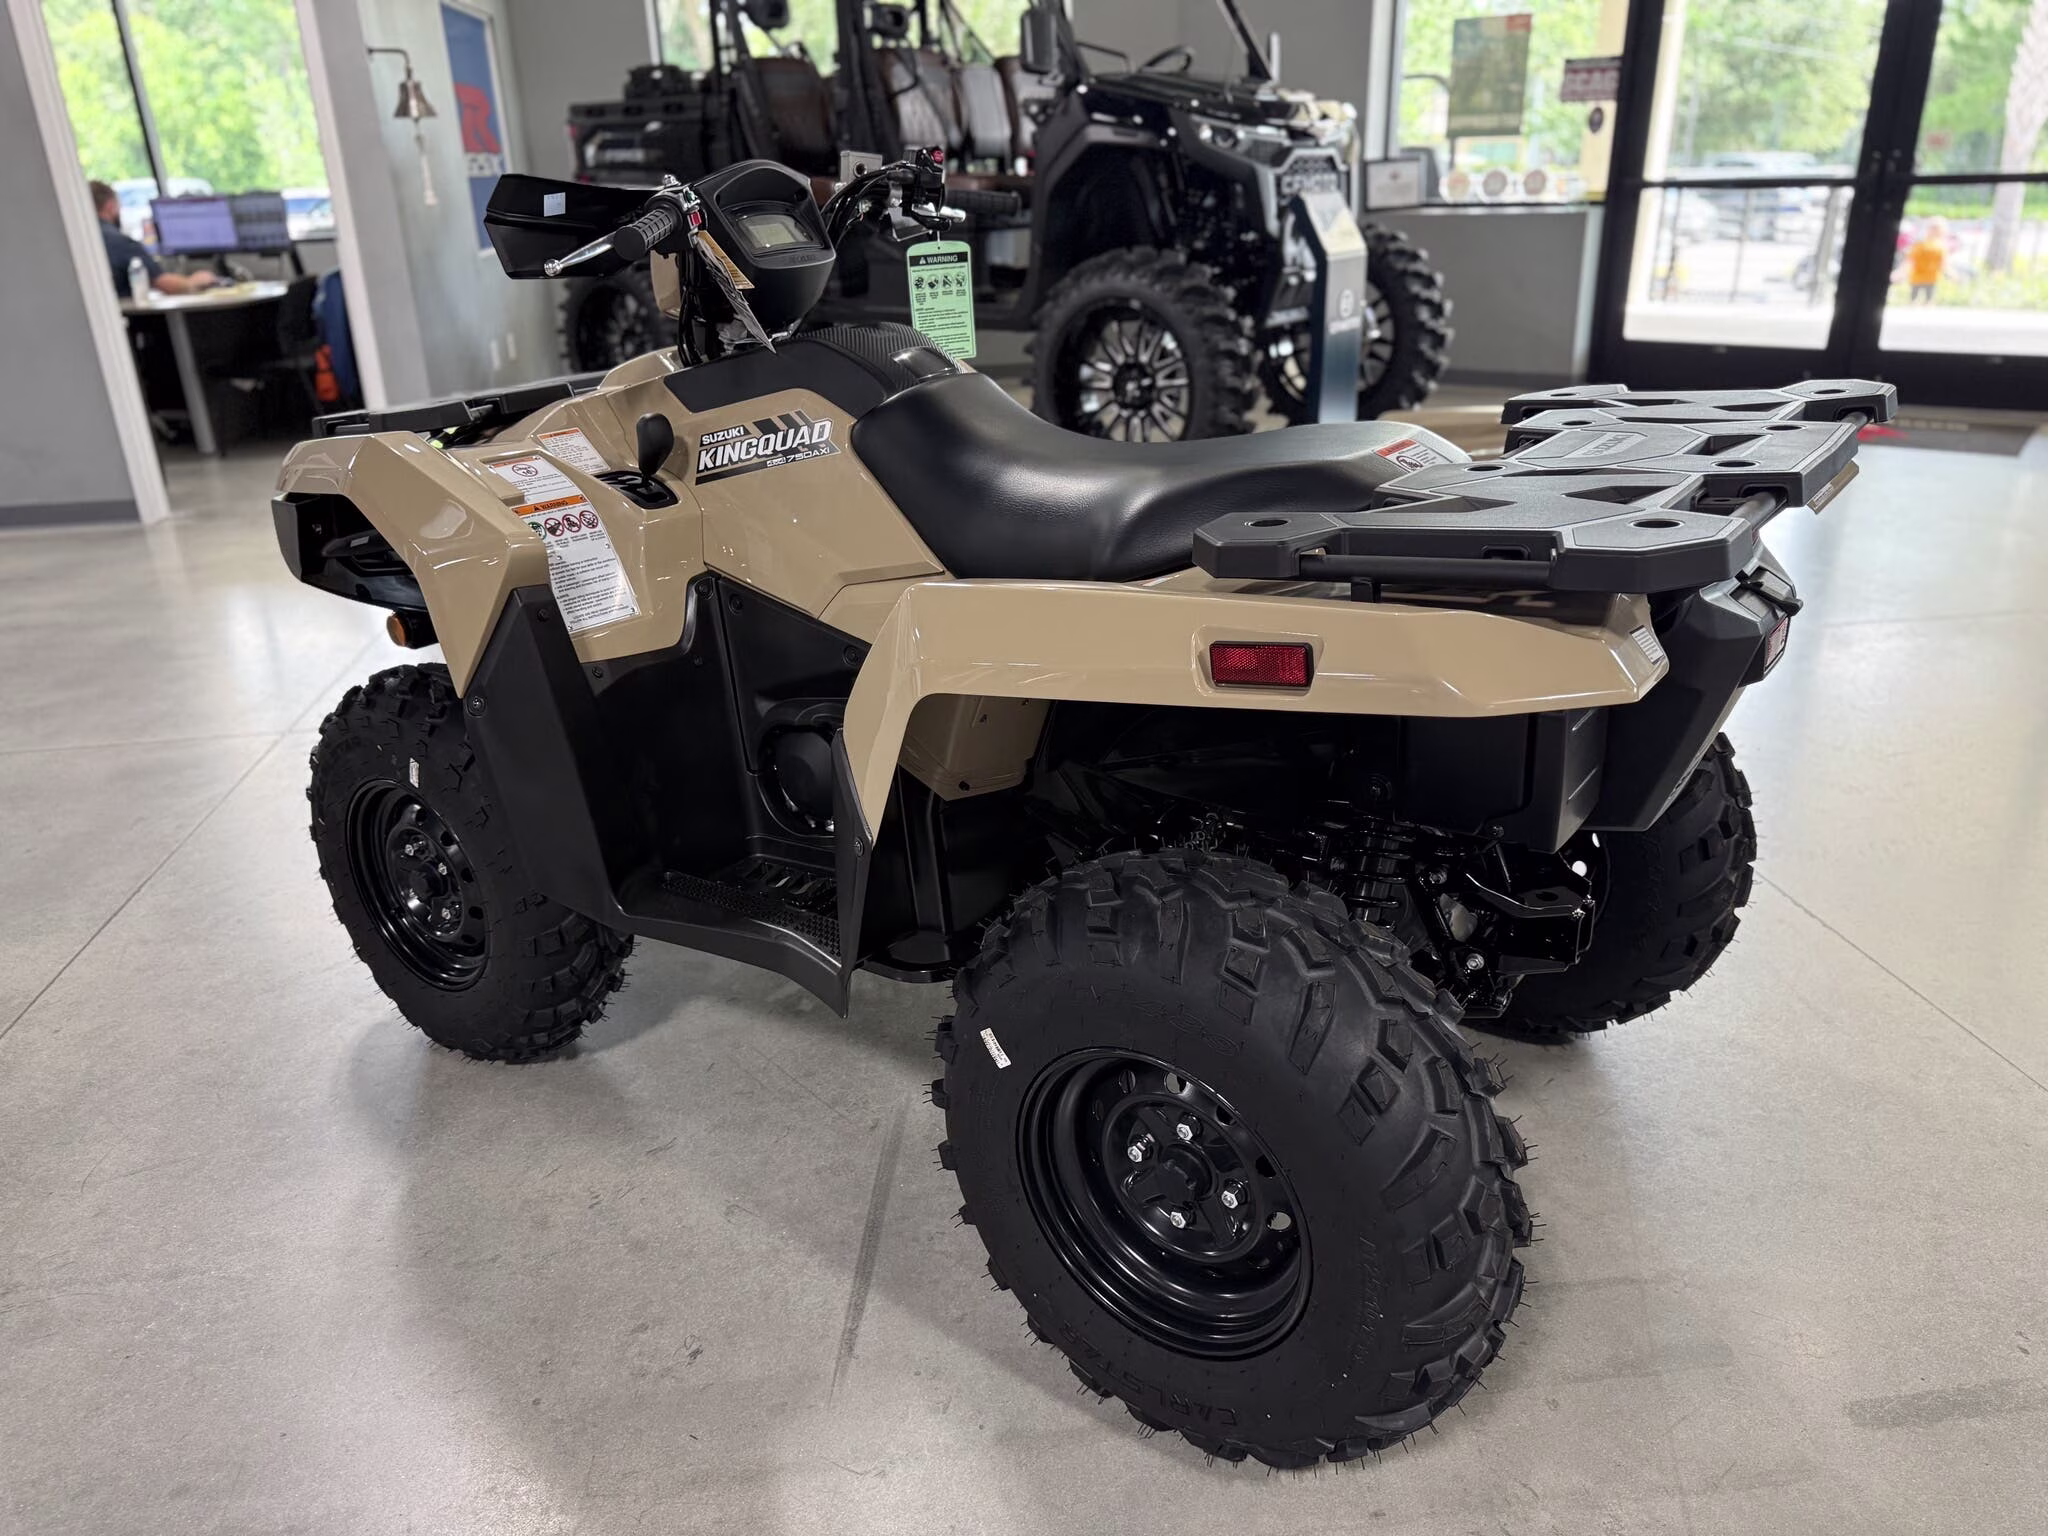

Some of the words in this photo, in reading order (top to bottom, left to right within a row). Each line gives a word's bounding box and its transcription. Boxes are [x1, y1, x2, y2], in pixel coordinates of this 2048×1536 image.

[926, 254, 958, 264] WARNING
[698, 420, 833, 472] KINGQUAD
[701, 426, 745, 446] SUZUKI
